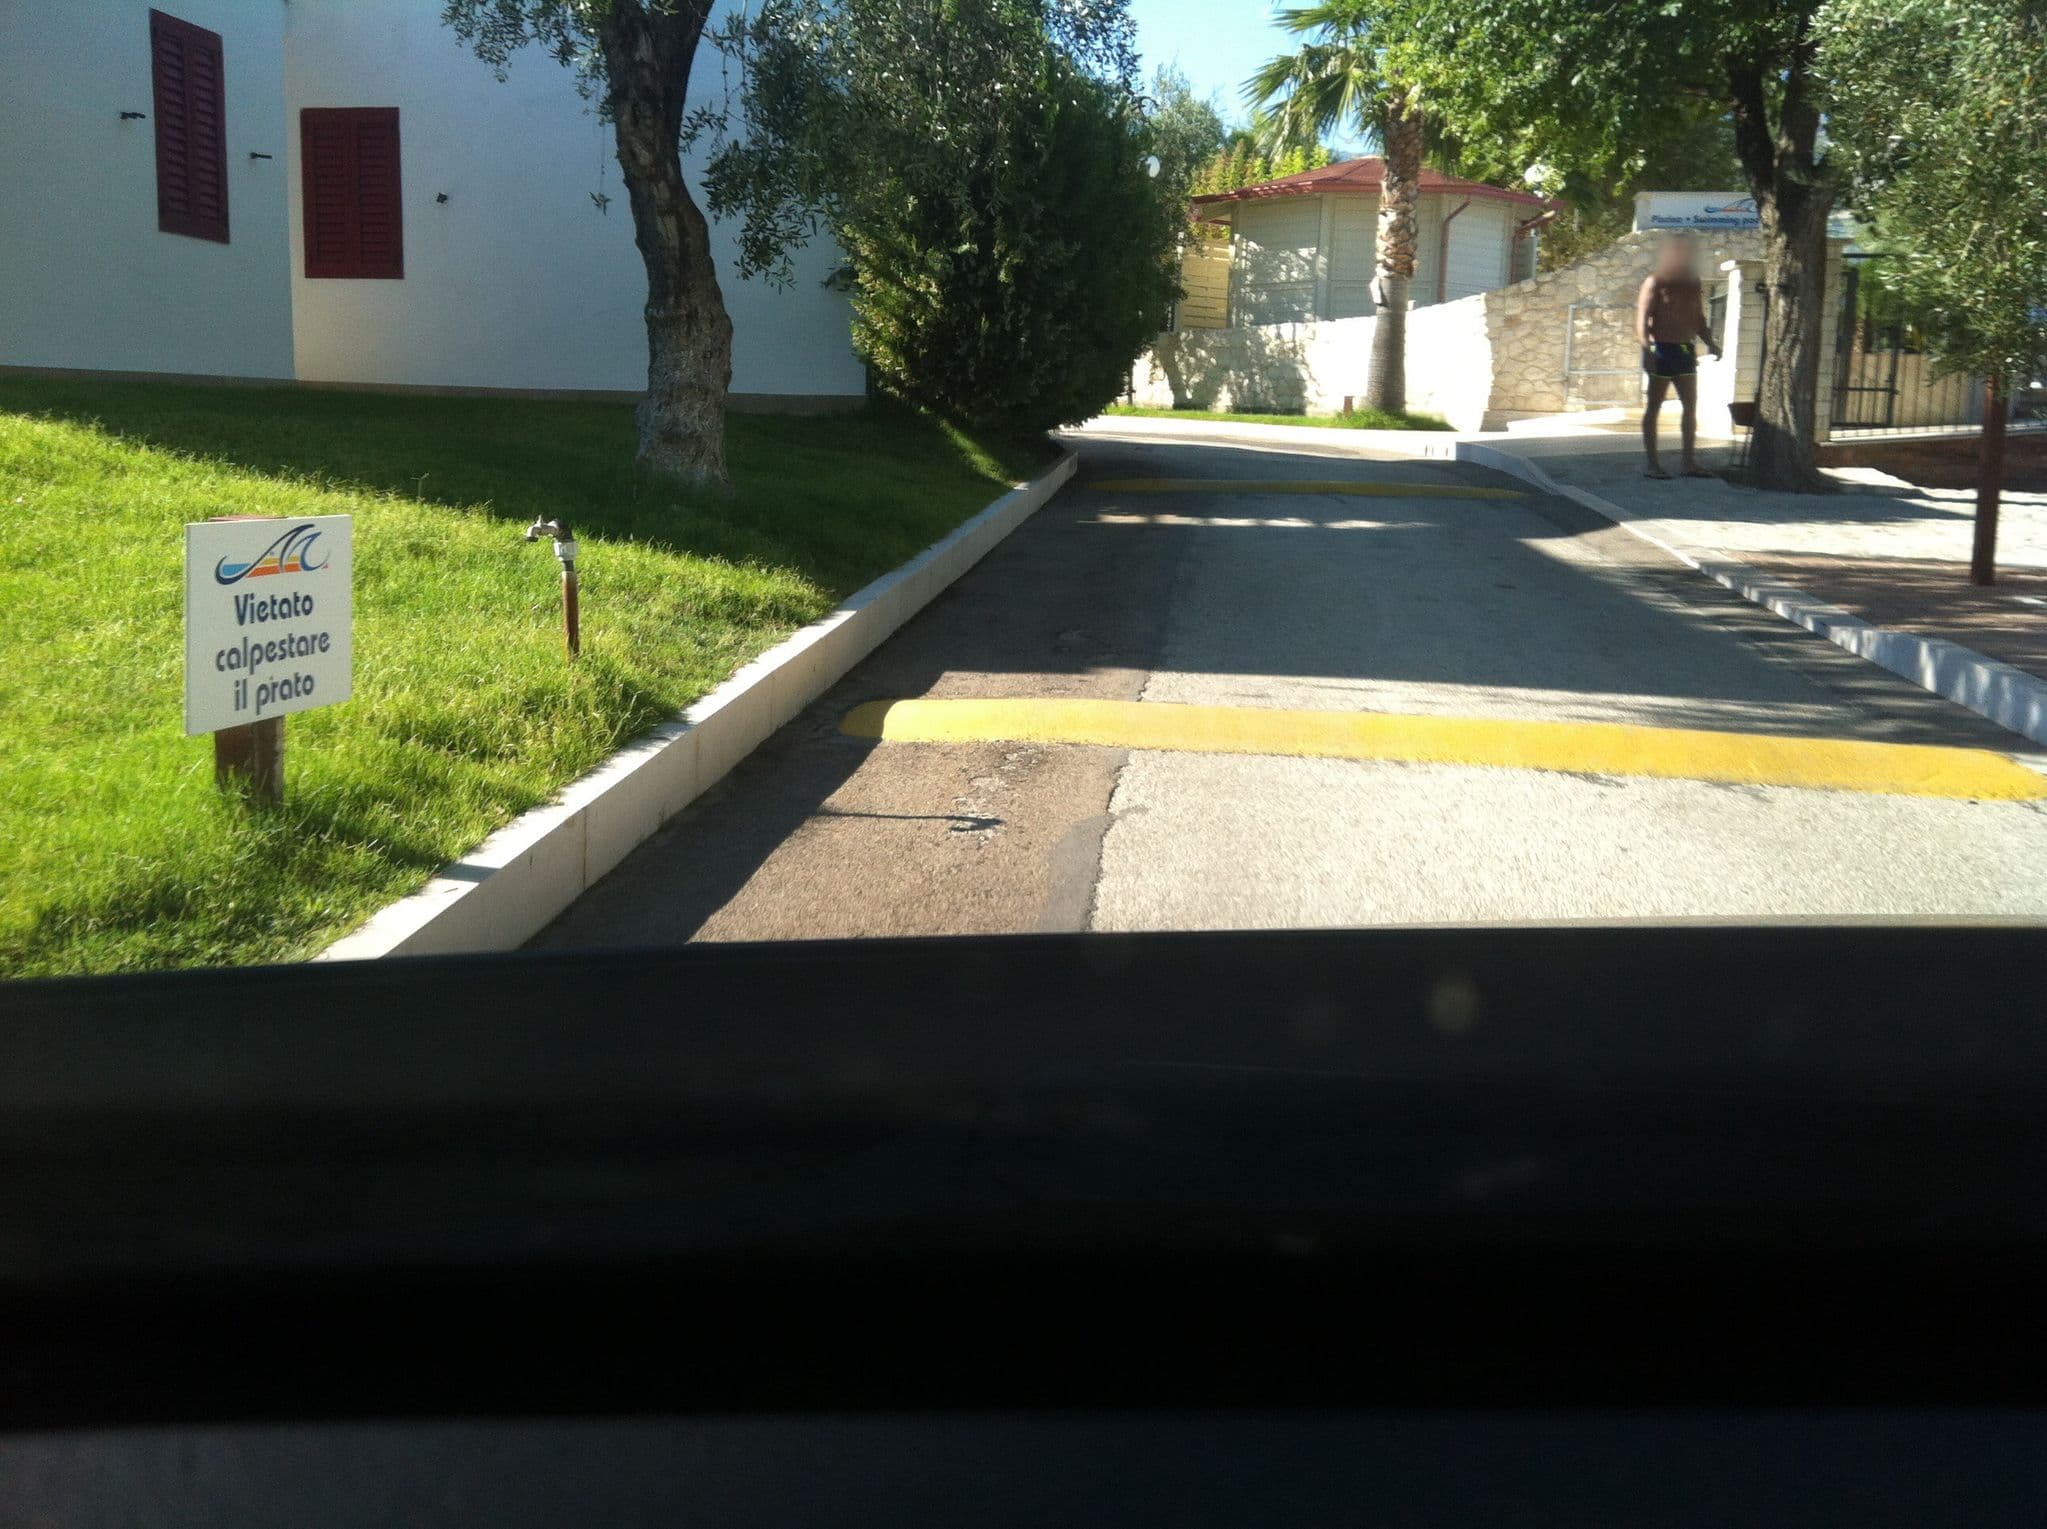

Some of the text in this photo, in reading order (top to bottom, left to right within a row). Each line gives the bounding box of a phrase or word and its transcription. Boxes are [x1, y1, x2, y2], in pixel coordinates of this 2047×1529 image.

[235, 592, 313, 626] Vietato
[216, 632, 330, 675] calpestare
[235, 672, 315, 716] il prato
